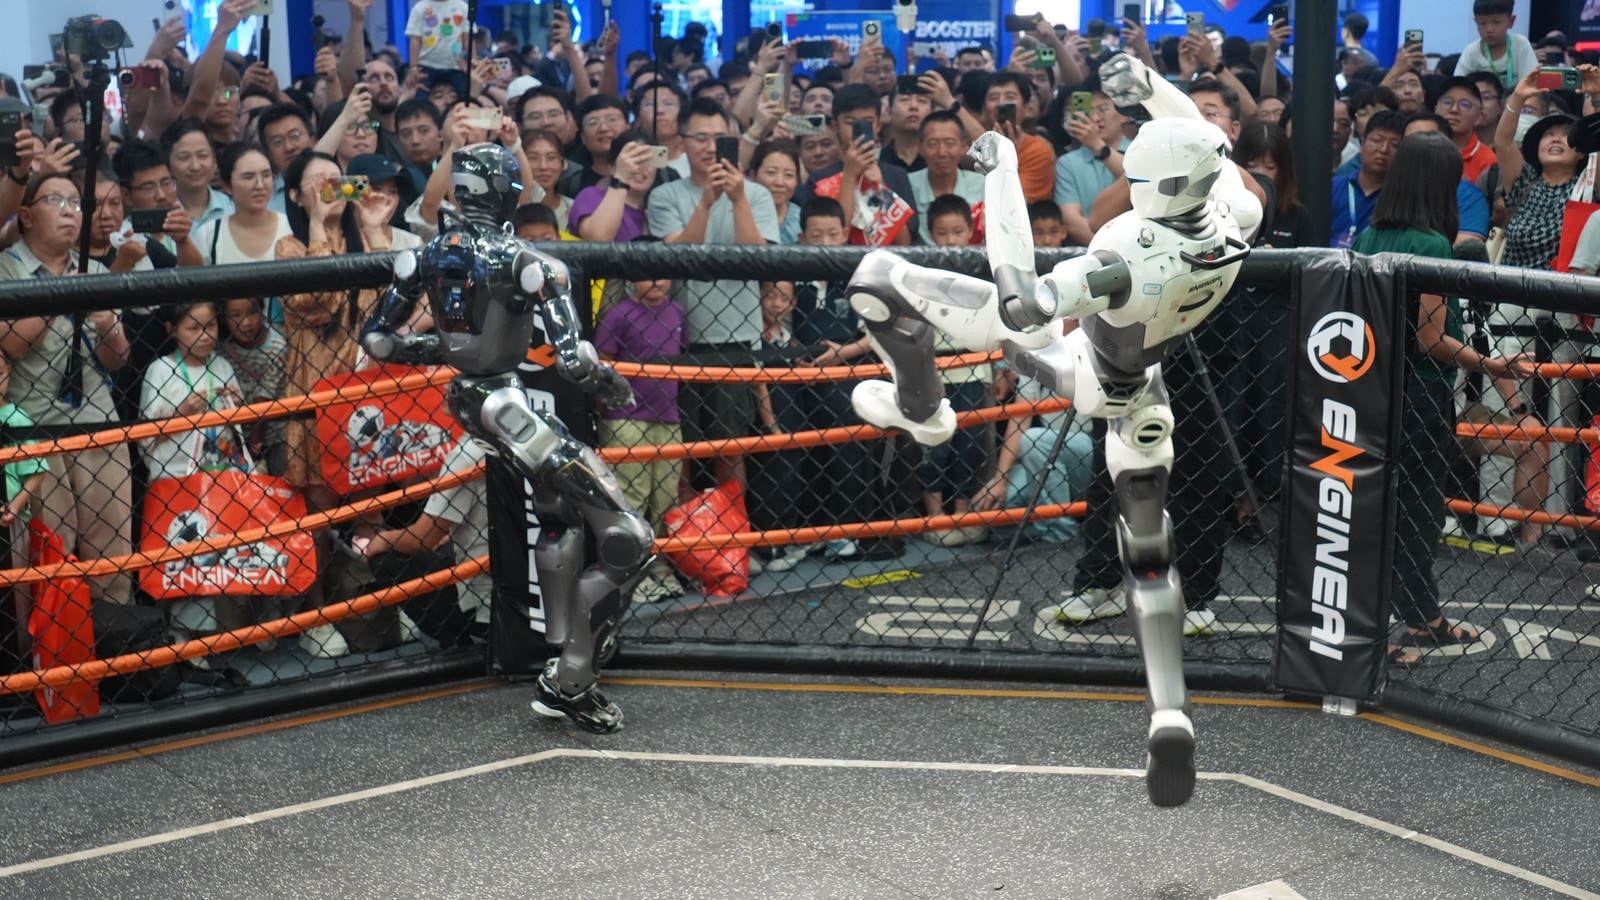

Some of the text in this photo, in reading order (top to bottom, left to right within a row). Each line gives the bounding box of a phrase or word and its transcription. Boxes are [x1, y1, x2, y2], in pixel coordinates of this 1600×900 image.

[915, 21, 996, 38] BOOSTER
[1308, 398, 1366, 661] ENGINEAI
[162, 566, 287, 590] ENGINEAI
